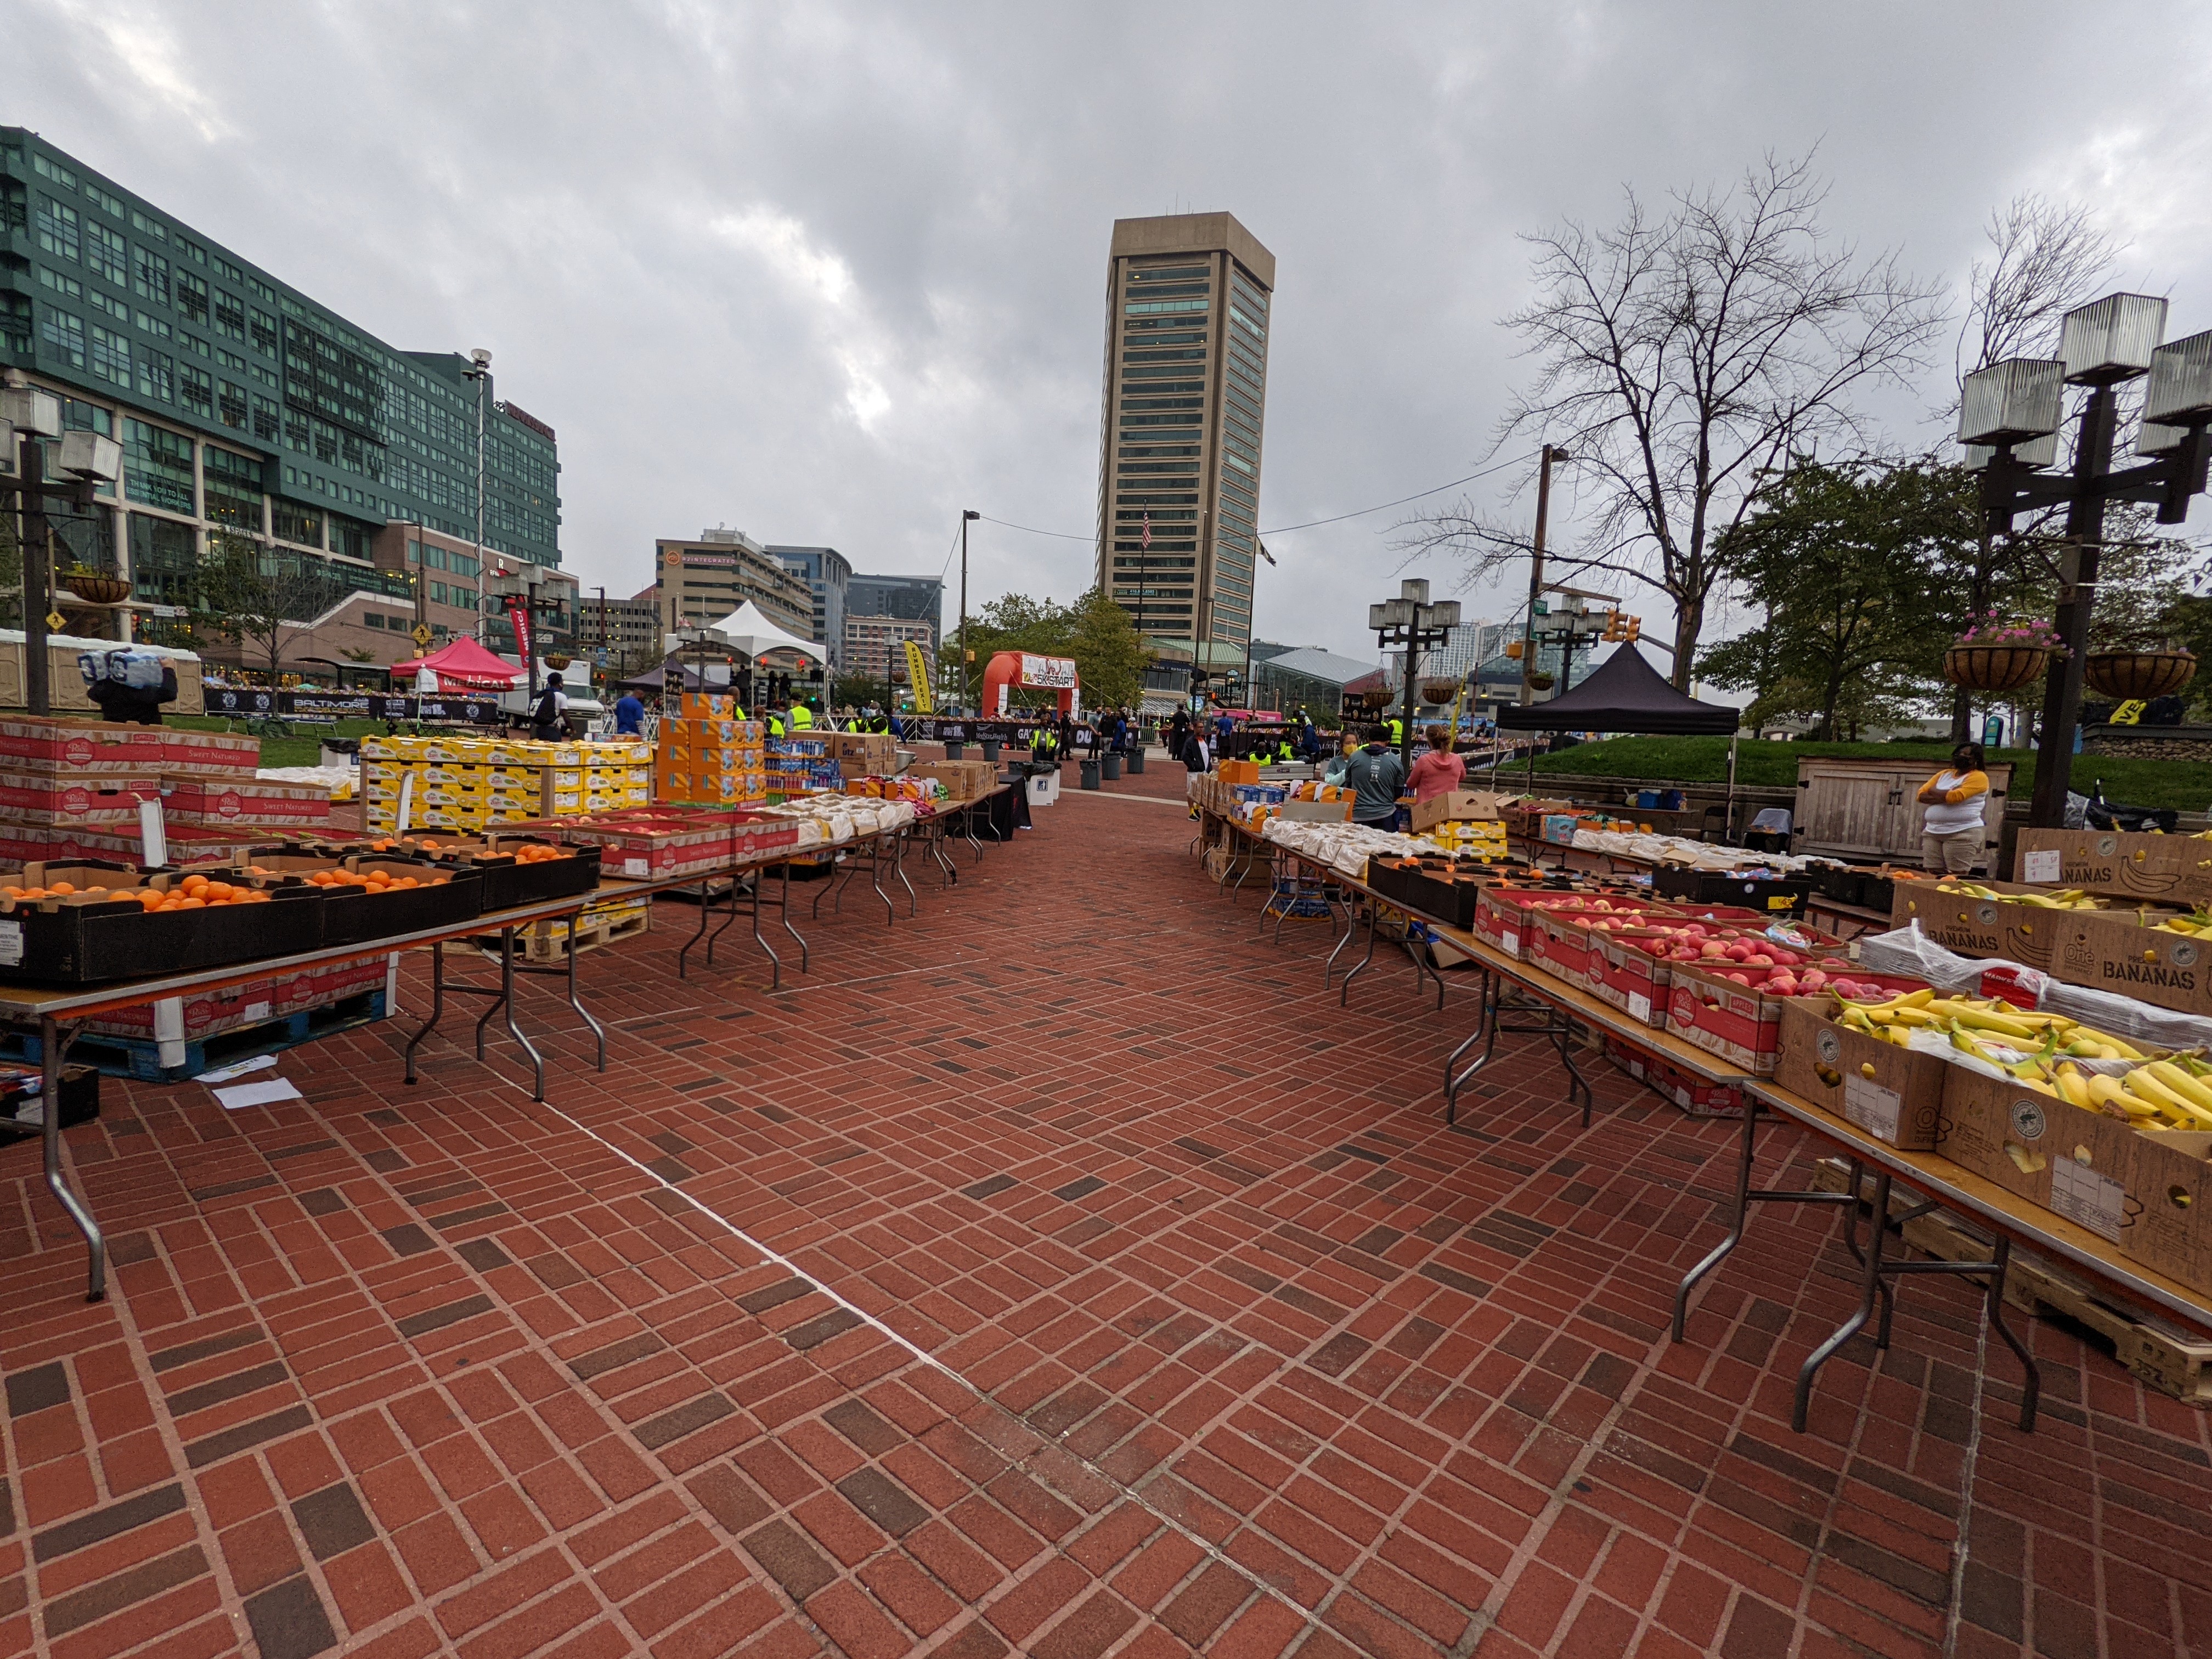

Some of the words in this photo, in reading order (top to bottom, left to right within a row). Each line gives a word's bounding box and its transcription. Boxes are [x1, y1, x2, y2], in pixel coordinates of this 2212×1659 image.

[161, 495, 192, 510] WORKERS
[498, 558, 504, 569] R
[516, 610, 529, 651] MEDIC
[911, 647, 922, 685] RUNNERS
[443, 676, 507, 689] MEDICAL
[1037, 674, 1048, 685] 5K
[1048, 675, 1074, 687] START
[294, 699, 369, 708] BALTIMORE
[189, 750, 209, 759] SWEET
[212, 752, 240, 761] NATURED
[2059, 867, 2111, 884] ANANAS
[1928, 930, 1999, 951] BANANAS
[2064, 944, 2095, 965] One
[333, 974, 351, 983] SWEET
[351, 968, 380, 980] NATURED
[2103, 961, 2195, 990] BANANAS
[1733, 999, 1753, 1013] APPLES
[117, 1012, 151, 1022] NATURED
